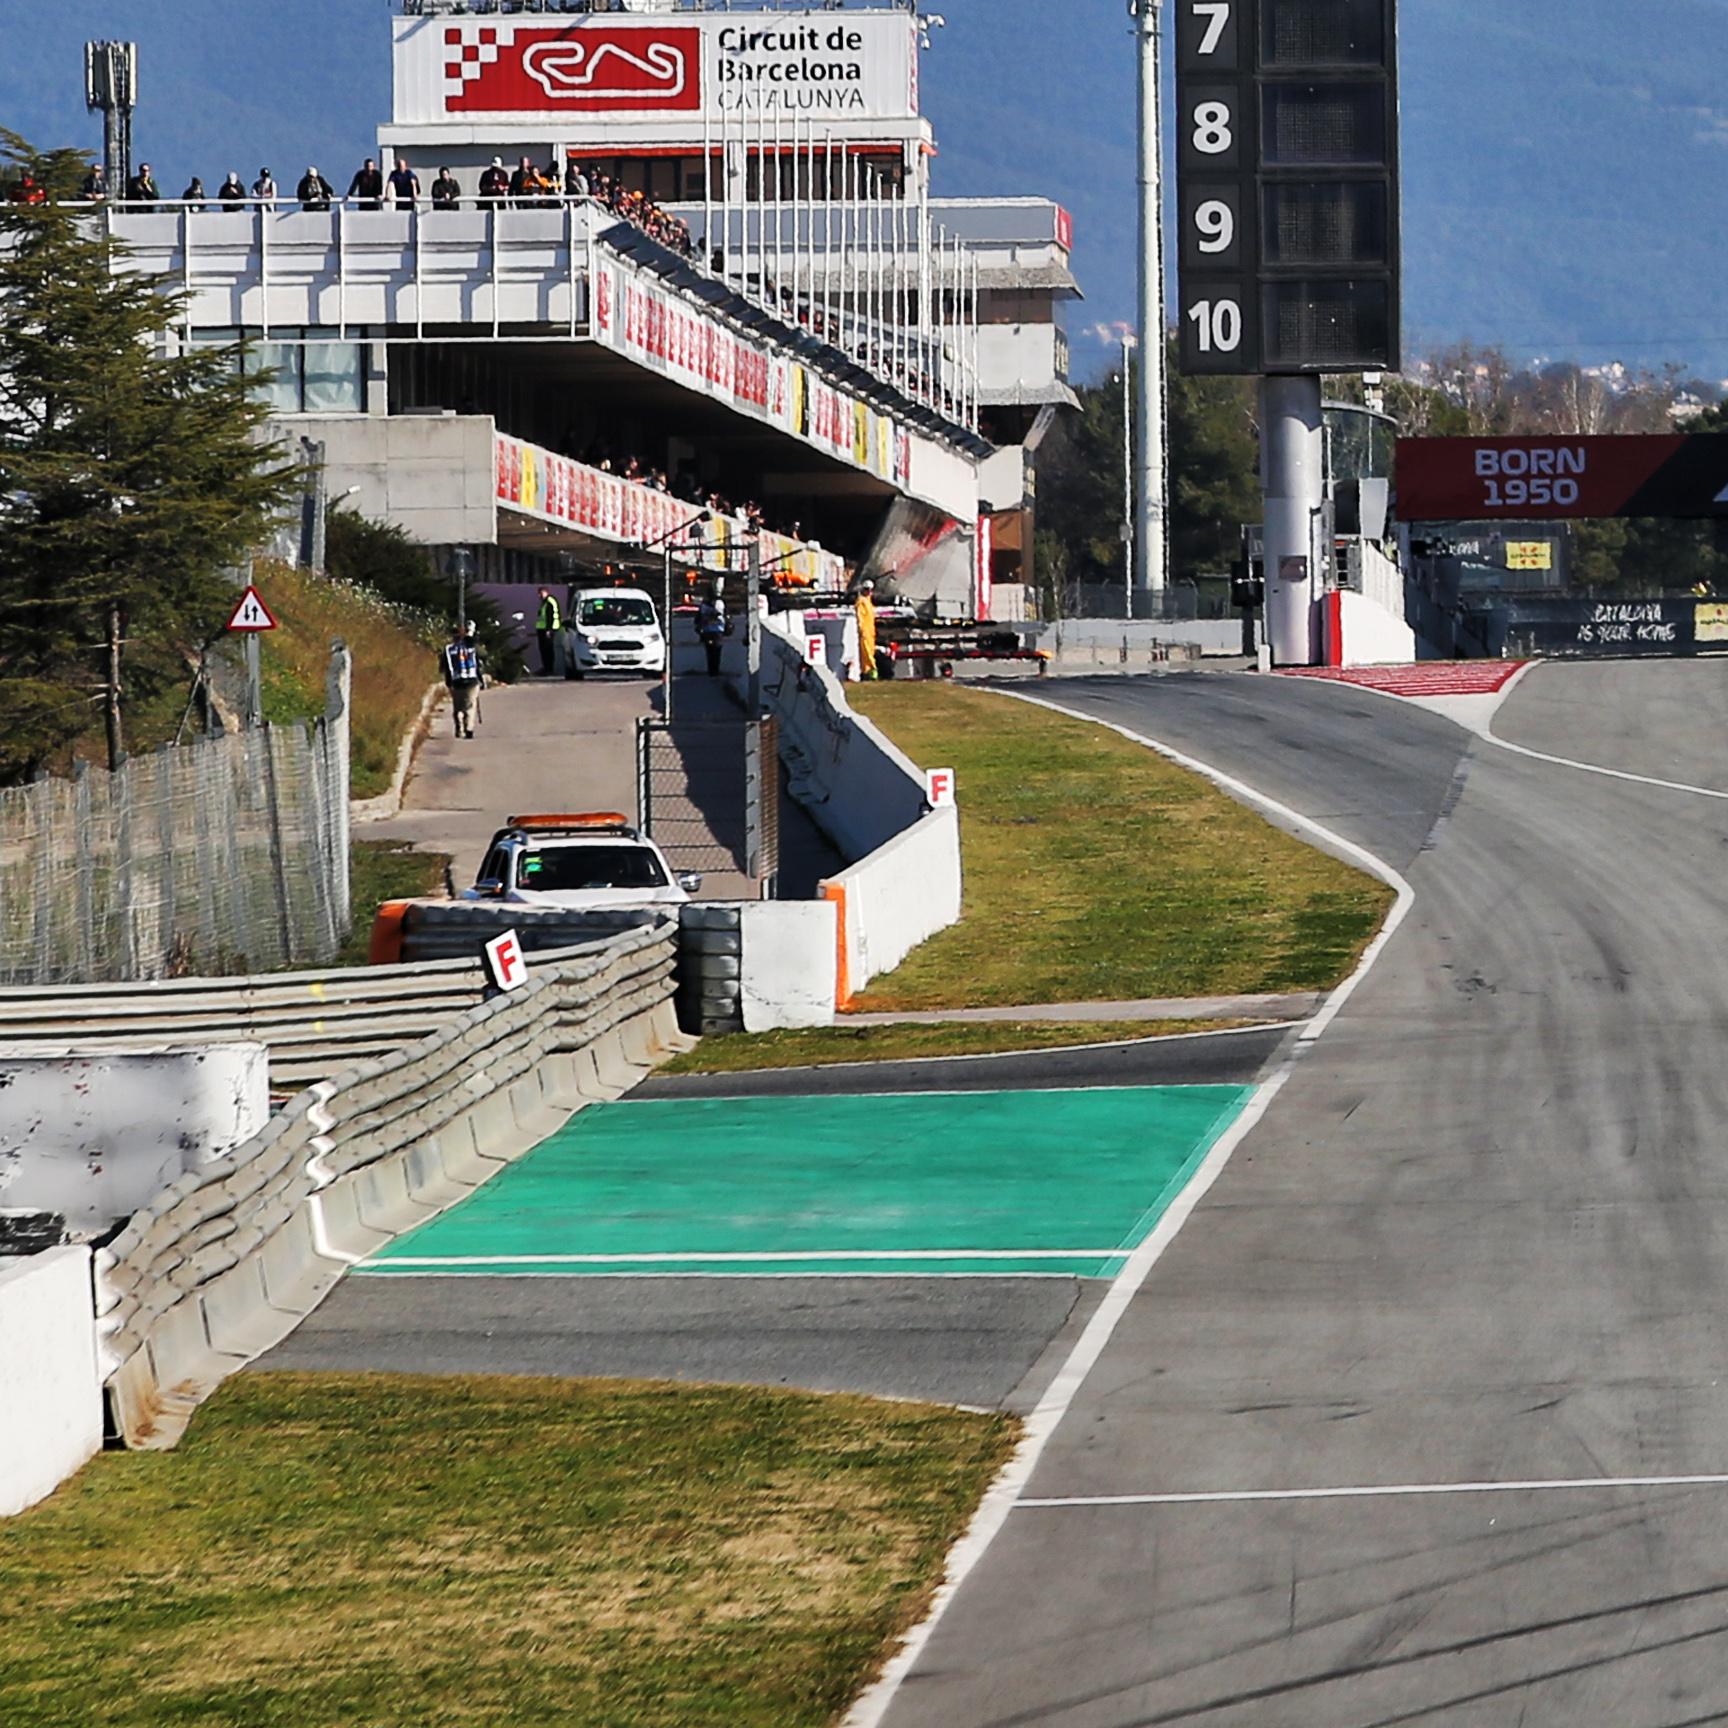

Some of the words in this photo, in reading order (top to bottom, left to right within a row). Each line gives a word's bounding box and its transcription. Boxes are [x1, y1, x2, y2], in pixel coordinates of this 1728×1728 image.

[718, 25, 819, 51] Circuit
[826, 25, 862, 51] de
[1192, 3, 1230, 54] 7
[718, 57, 861, 82] Barcelona
[718, 88, 865, 110] CATALUNYA
[1192, 101, 1232, 154] 8
[1195, 200, 1233, 253] 9
[1187, 298, 1242, 353] 10
[1475, 447, 1585, 476] BORN
[1484, 478, 1578, 506] 1950
[809, 639, 821, 660] F
[932, 775, 948, 802] F
[495, 939, 517, 983] F
